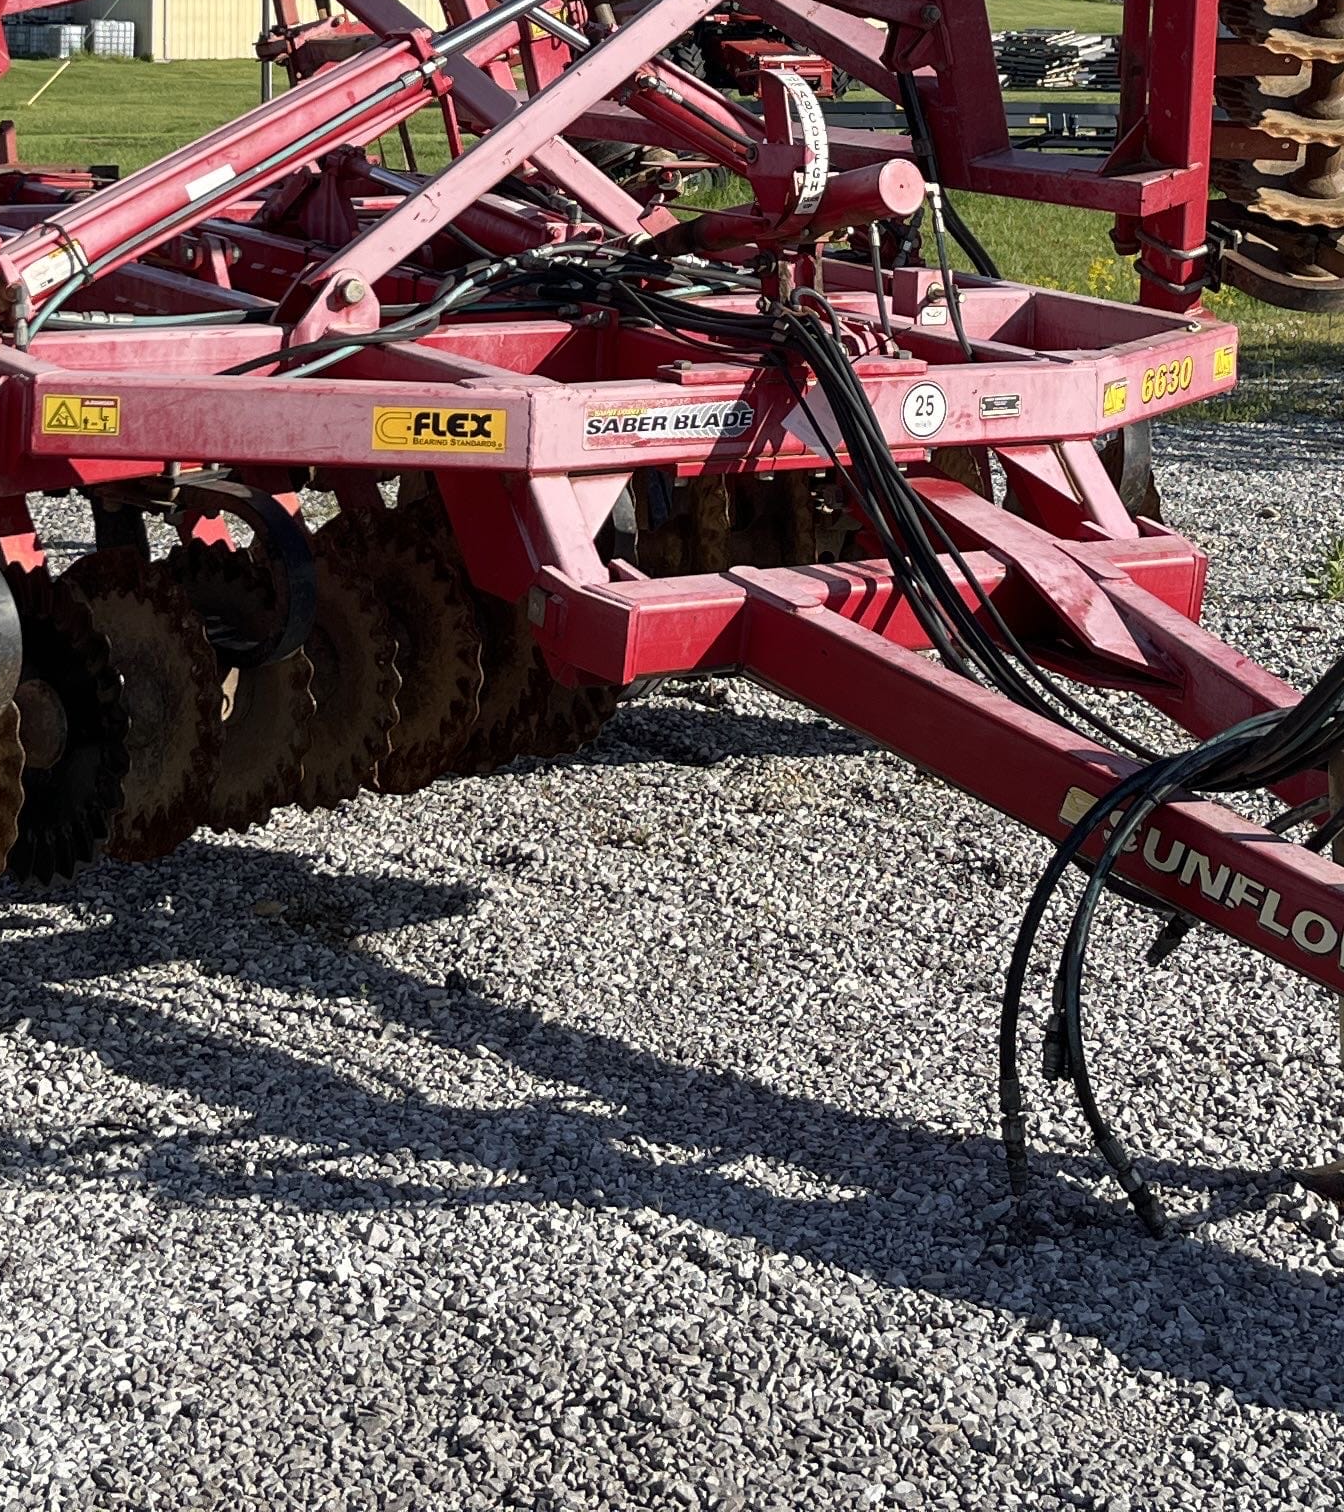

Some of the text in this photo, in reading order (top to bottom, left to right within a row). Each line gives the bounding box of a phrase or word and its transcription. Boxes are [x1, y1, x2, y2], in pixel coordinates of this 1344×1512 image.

[804, 100, 813, 110] B
[808, 112, 816, 124] C
[814, 139, 821, 151] E
[814, 153, 821, 164] F
[812, 167, 821, 179] G
[809, 181, 819, 192] H
[1141, 355, 1194, 404] 6630
[915, 394, 935, 417] 25
[586, 410, 754, 435] SABER BLADE
